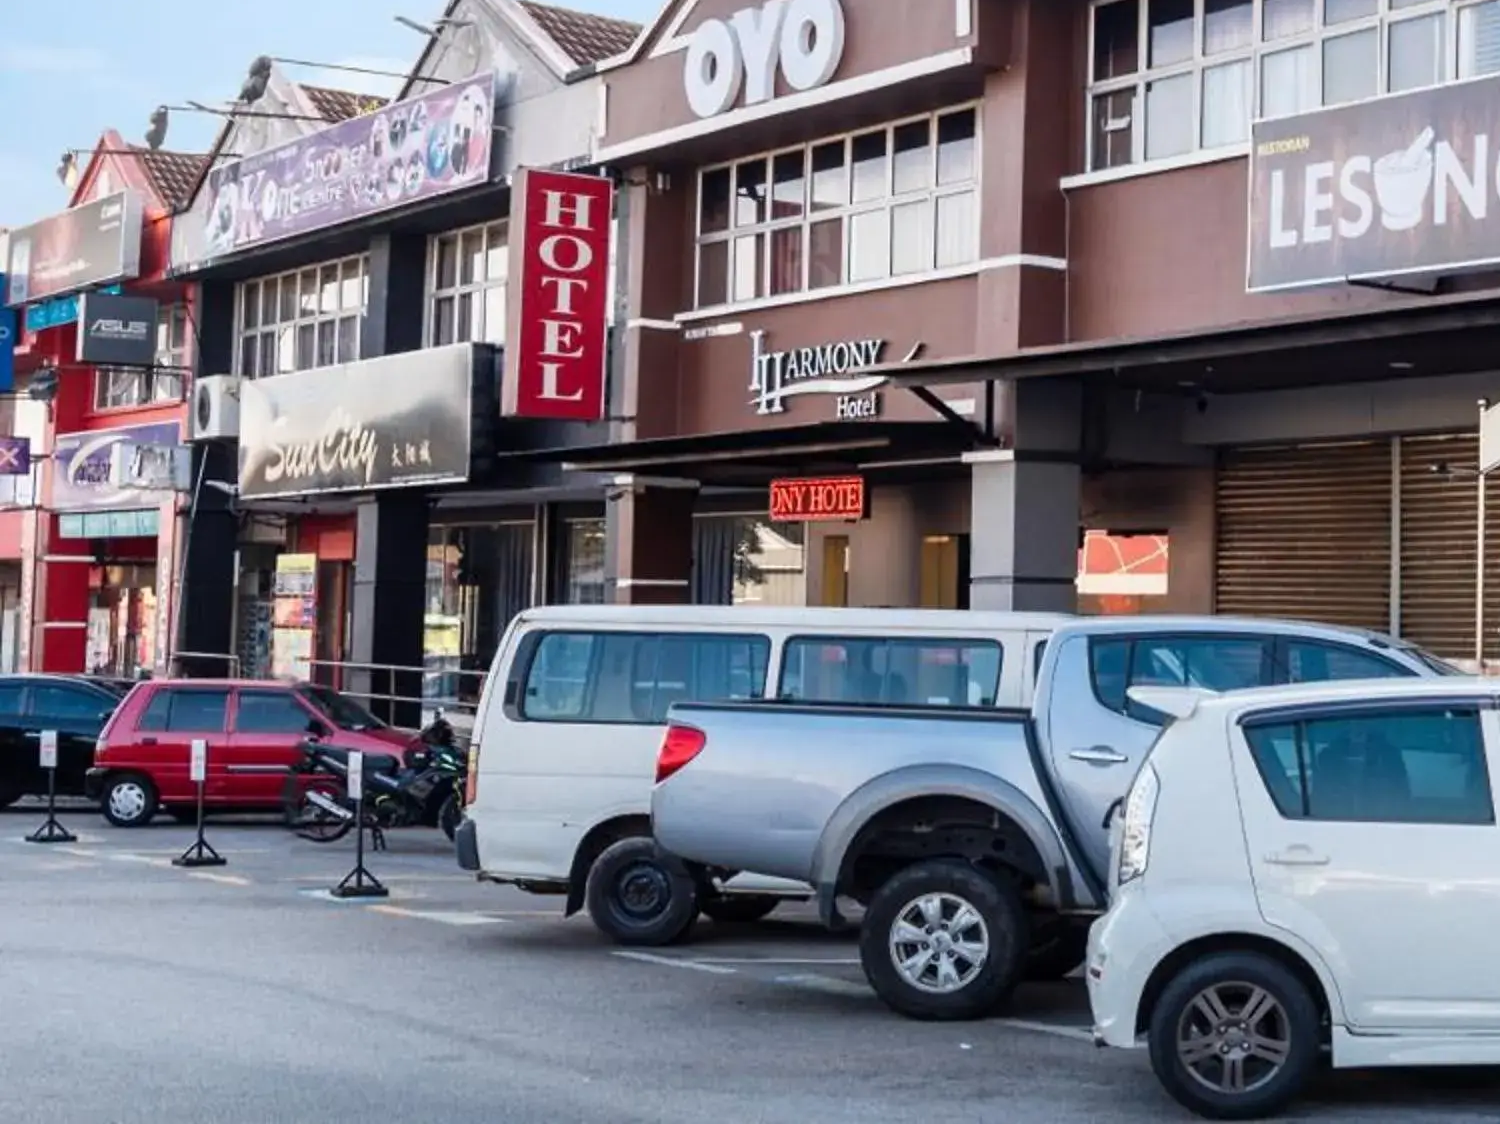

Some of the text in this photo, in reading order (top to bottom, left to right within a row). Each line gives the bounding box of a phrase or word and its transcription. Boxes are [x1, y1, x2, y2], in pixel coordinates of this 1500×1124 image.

[534, 188, 600, 401] HOTEL
[90, 319, 148, 334] ASUS
[836, 391, 877, 418] Hotel
